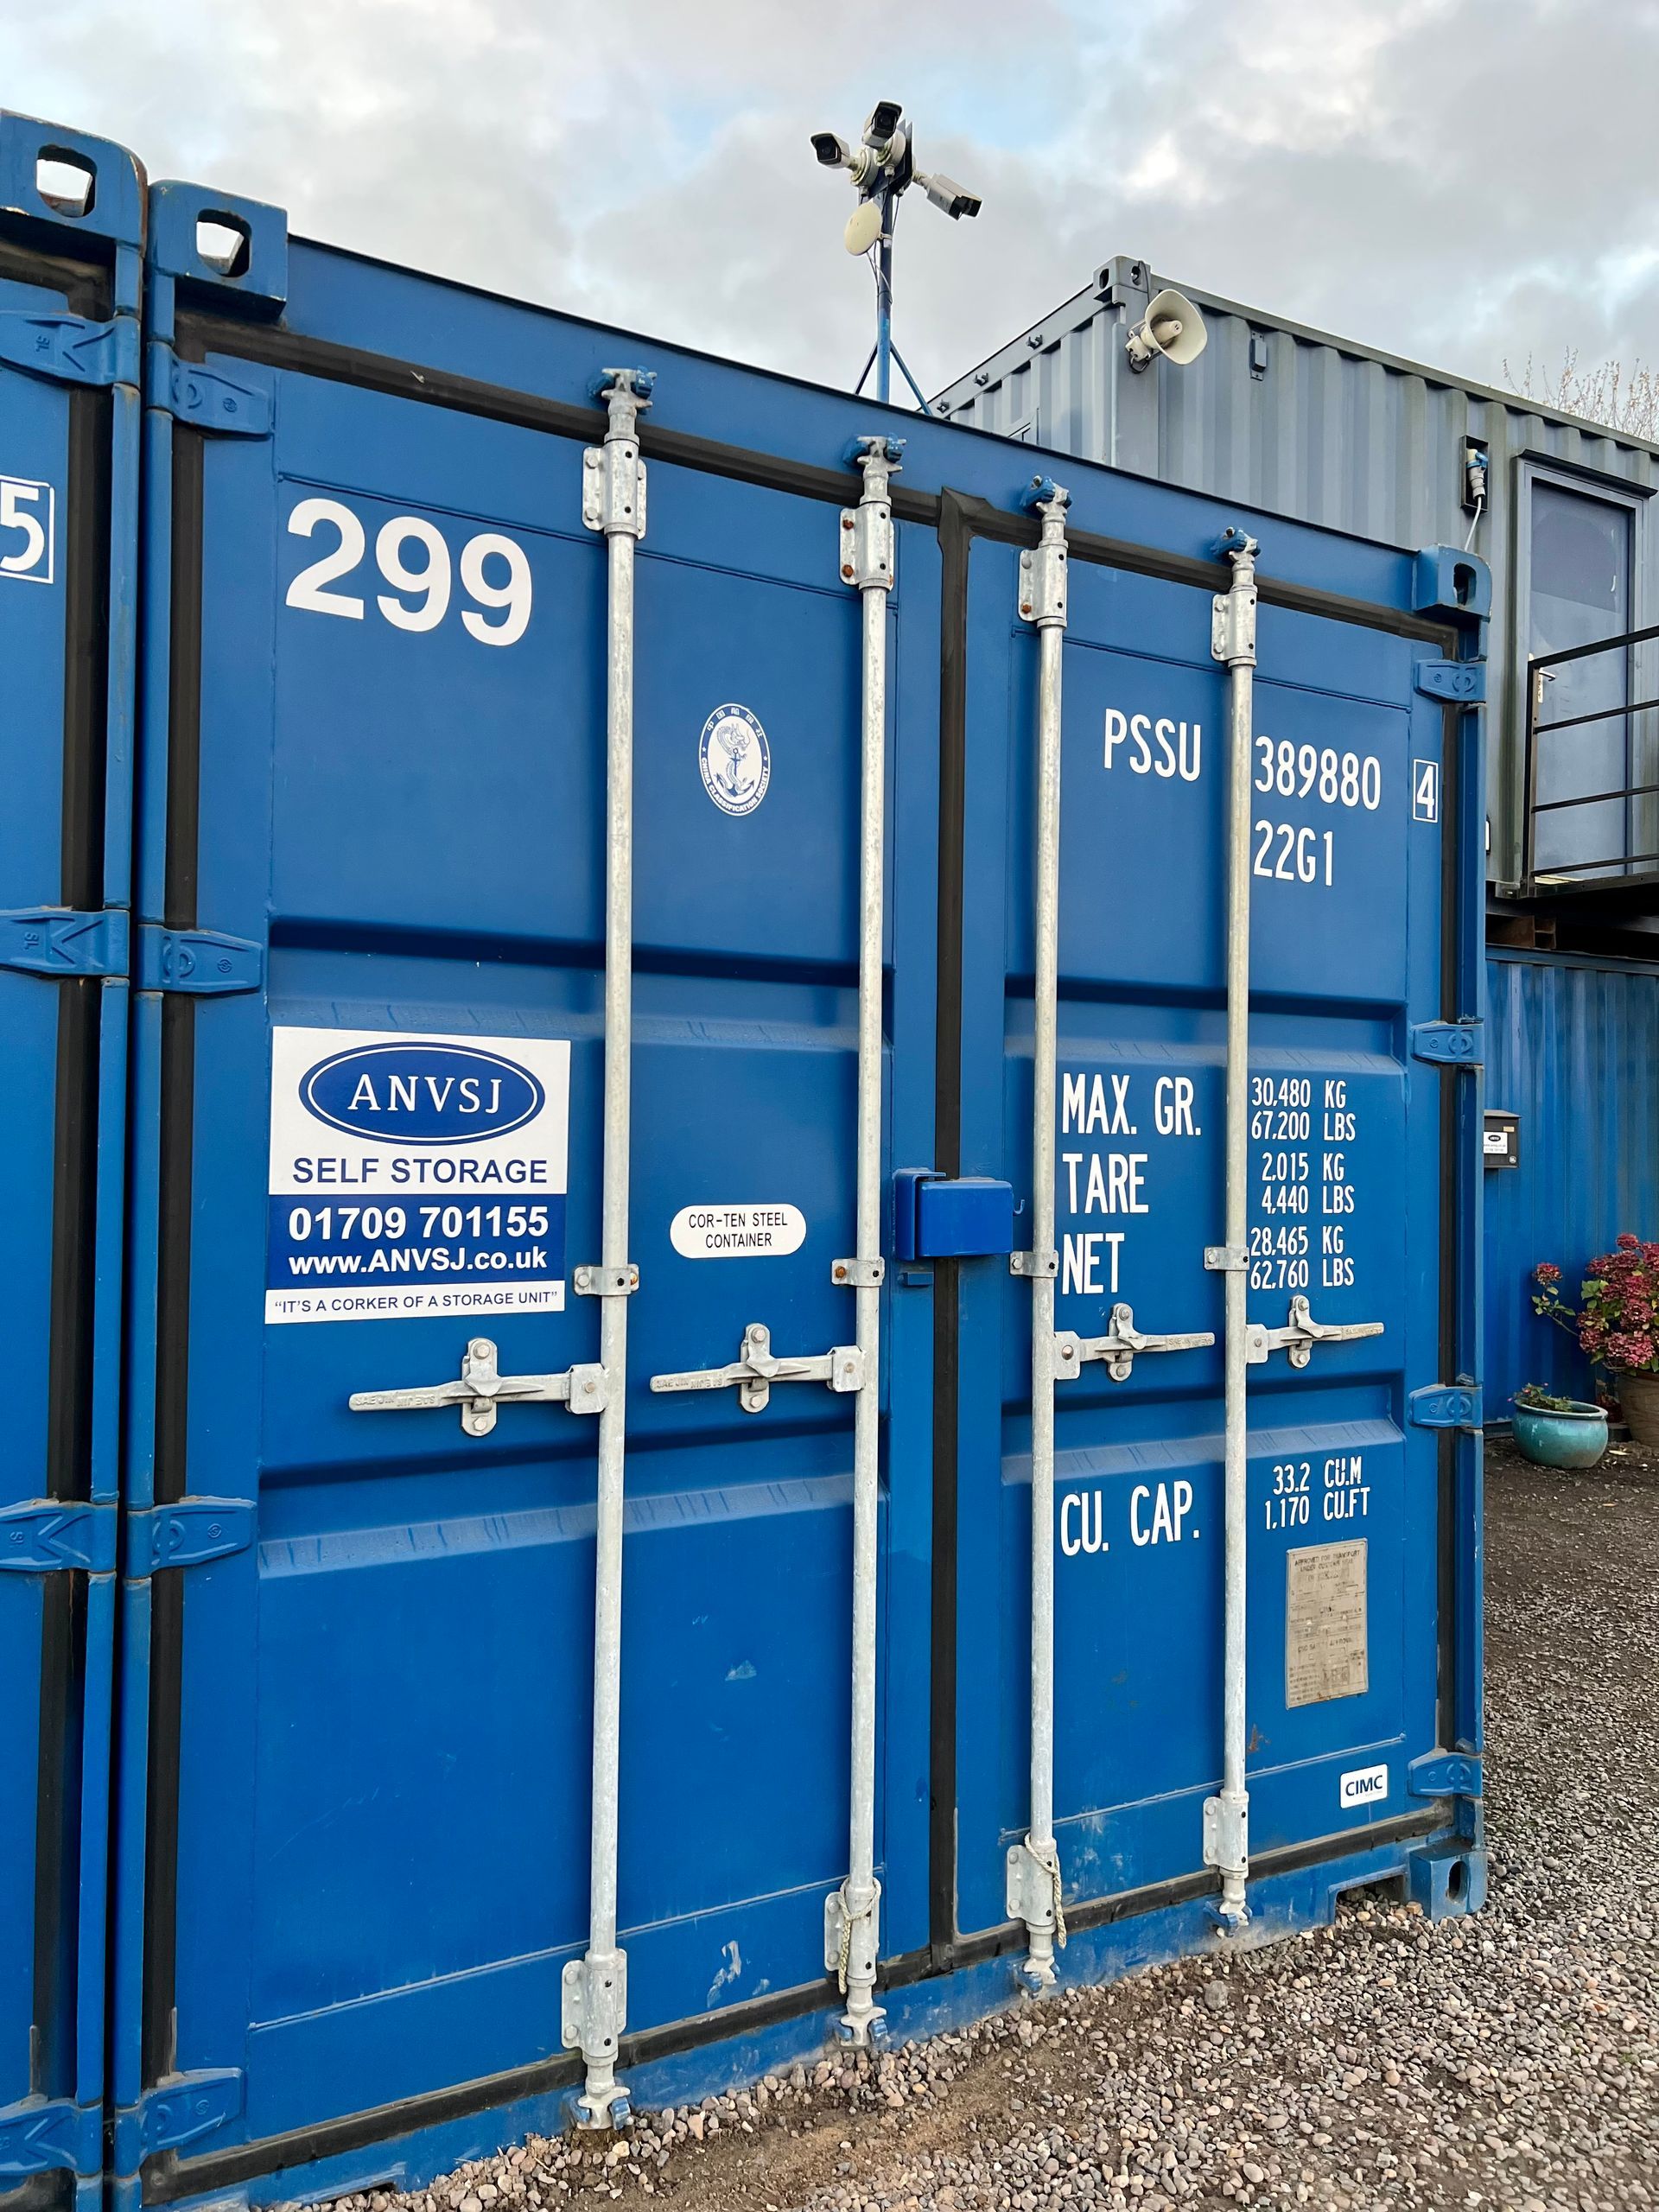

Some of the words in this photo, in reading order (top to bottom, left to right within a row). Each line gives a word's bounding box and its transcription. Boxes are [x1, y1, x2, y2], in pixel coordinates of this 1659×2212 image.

[0, 482, 45, 572] 5
[285, 498, 532, 646] 299
[1103, 708, 1201, 782] PSSU
[1255, 735, 1381, 810] 389880
[1416, 765, 1435, 818] 4
[1253, 819, 1334, 887] 22G1
[346, 1073, 502, 1114] ANVSJ
[1062, 1072, 1137, 1135] MAX.
[1154, 1076, 1201, 1136] GR.
[1251, 1077, 1311, 1108] 30,480
[1325, 1079, 1346, 1109] KG
[1251, 1110, 1310, 1141] 67,200
[1324, 1112, 1356, 1141] LBS
[292, 1157, 379, 1184] SELF
[391, 1158, 548, 1184] STORAGE
[1062, 1153, 1149, 1214] TARE
[1262, 1152, 1309, 1181] 2,015
[1323, 1153, 1344, 1181] KG
[1261, 1185, 1309, 1215] 4,440
[1322, 1185, 1355, 1214] LBS
[289, 1207, 406, 1241] 01709
[419, 1205, 549, 1238] 701155
[689, 1212, 746, 1229] COR-TEN
[752, 1211, 788, 1227] STEEL
[705, 1232, 772, 1249] CONTAINER
[1250, 1225, 1309, 1256] 28,465
[1322, 1225, 1344, 1255] KG
[288, 1245, 548, 1275] www.ANVSJ.co.uk
[1062, 1232, 1125, 1295] NET
[1250, 1258, 1309, 1290] 62,760
[1322, 1257, 1355, 1287] LBS
[315, 1300, 327, 1312] A
[331, 1297, 398, 1311] CORKER
[403, 1296, 423, 1308] OF
[428, 1295, 438, 1307] A
[442, 1293, 513, 1306] STORAGE
[1273, 1462, 1311, 1496] 33.2
[1324, 1456, 1362, 1489] CU.M
[1060, 1491, 1109, 1556] CU.
[1130, 1480, 1199, 1547] CAP.
[1265, 1495, 1310, 1530] 1,170
[1323, 1486, 1370, 1521] CU.FT
[1345, 1774, 1383, 1797] CIMC
